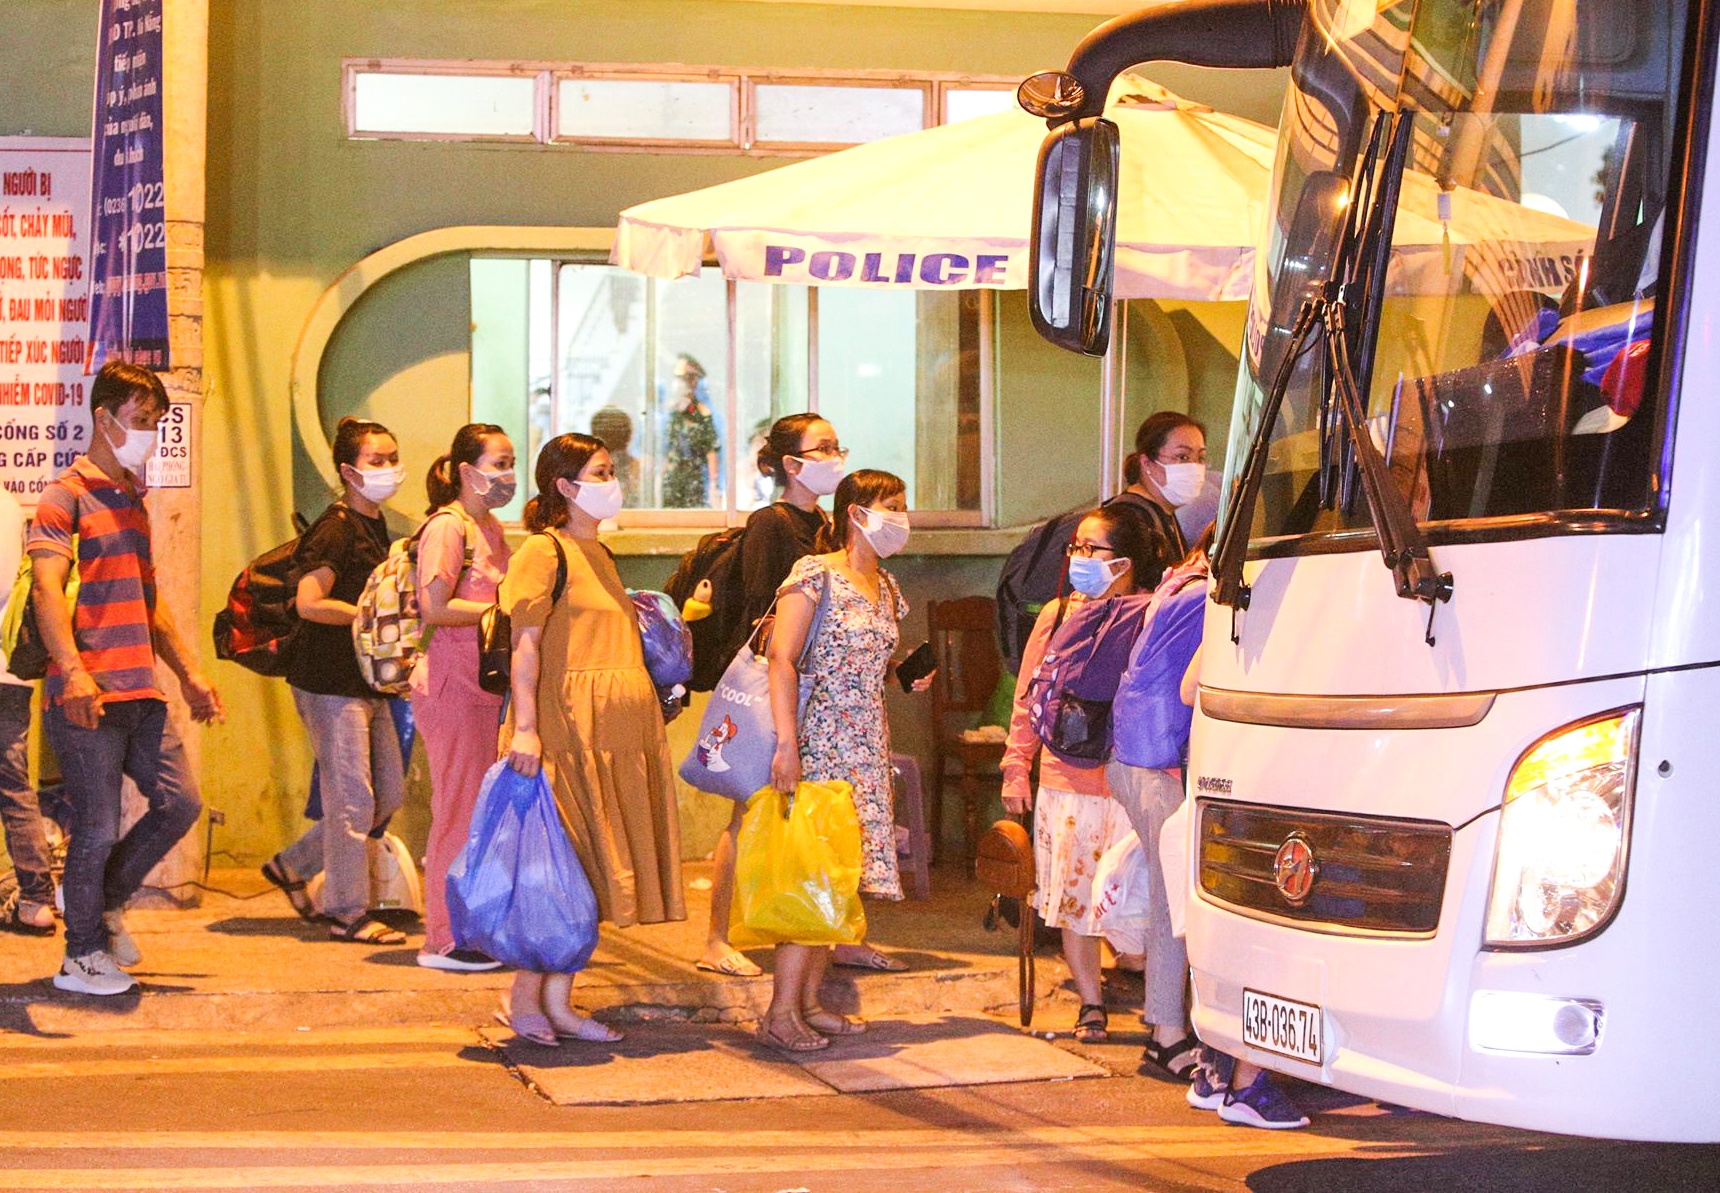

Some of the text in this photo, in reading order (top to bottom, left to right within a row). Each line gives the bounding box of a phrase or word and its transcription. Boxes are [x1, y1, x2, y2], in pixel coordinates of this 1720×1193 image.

[3, 166, 51, 202] NGƯỜI BỊ
[128, 181, 164, 213] 1022
[20, 206, 49, 238] CHẢY
[0, 251, 83, 286] ỌNG, TỨC NGỰC
[764, 245, 1009, 285] POLICE
[9, 298, 31, 322] ĐAU
[34, 291, 55, 322] MỎI
[58, 292, 89, 323] NGƯỜ
[0, 332, 22, 364] TIẾP
[26, 334, 48, 364] XÚC
[51, 334, 85, 365] NGƯỜI
[34, 382, 84, 407] COVID-19
[45, 420, 68, 441] SỐ
[73, 425, 84, 441] 2
[13, 447, 47, 468] CẤP
[1245, 995, 1318, 1057] 43B-036.74
